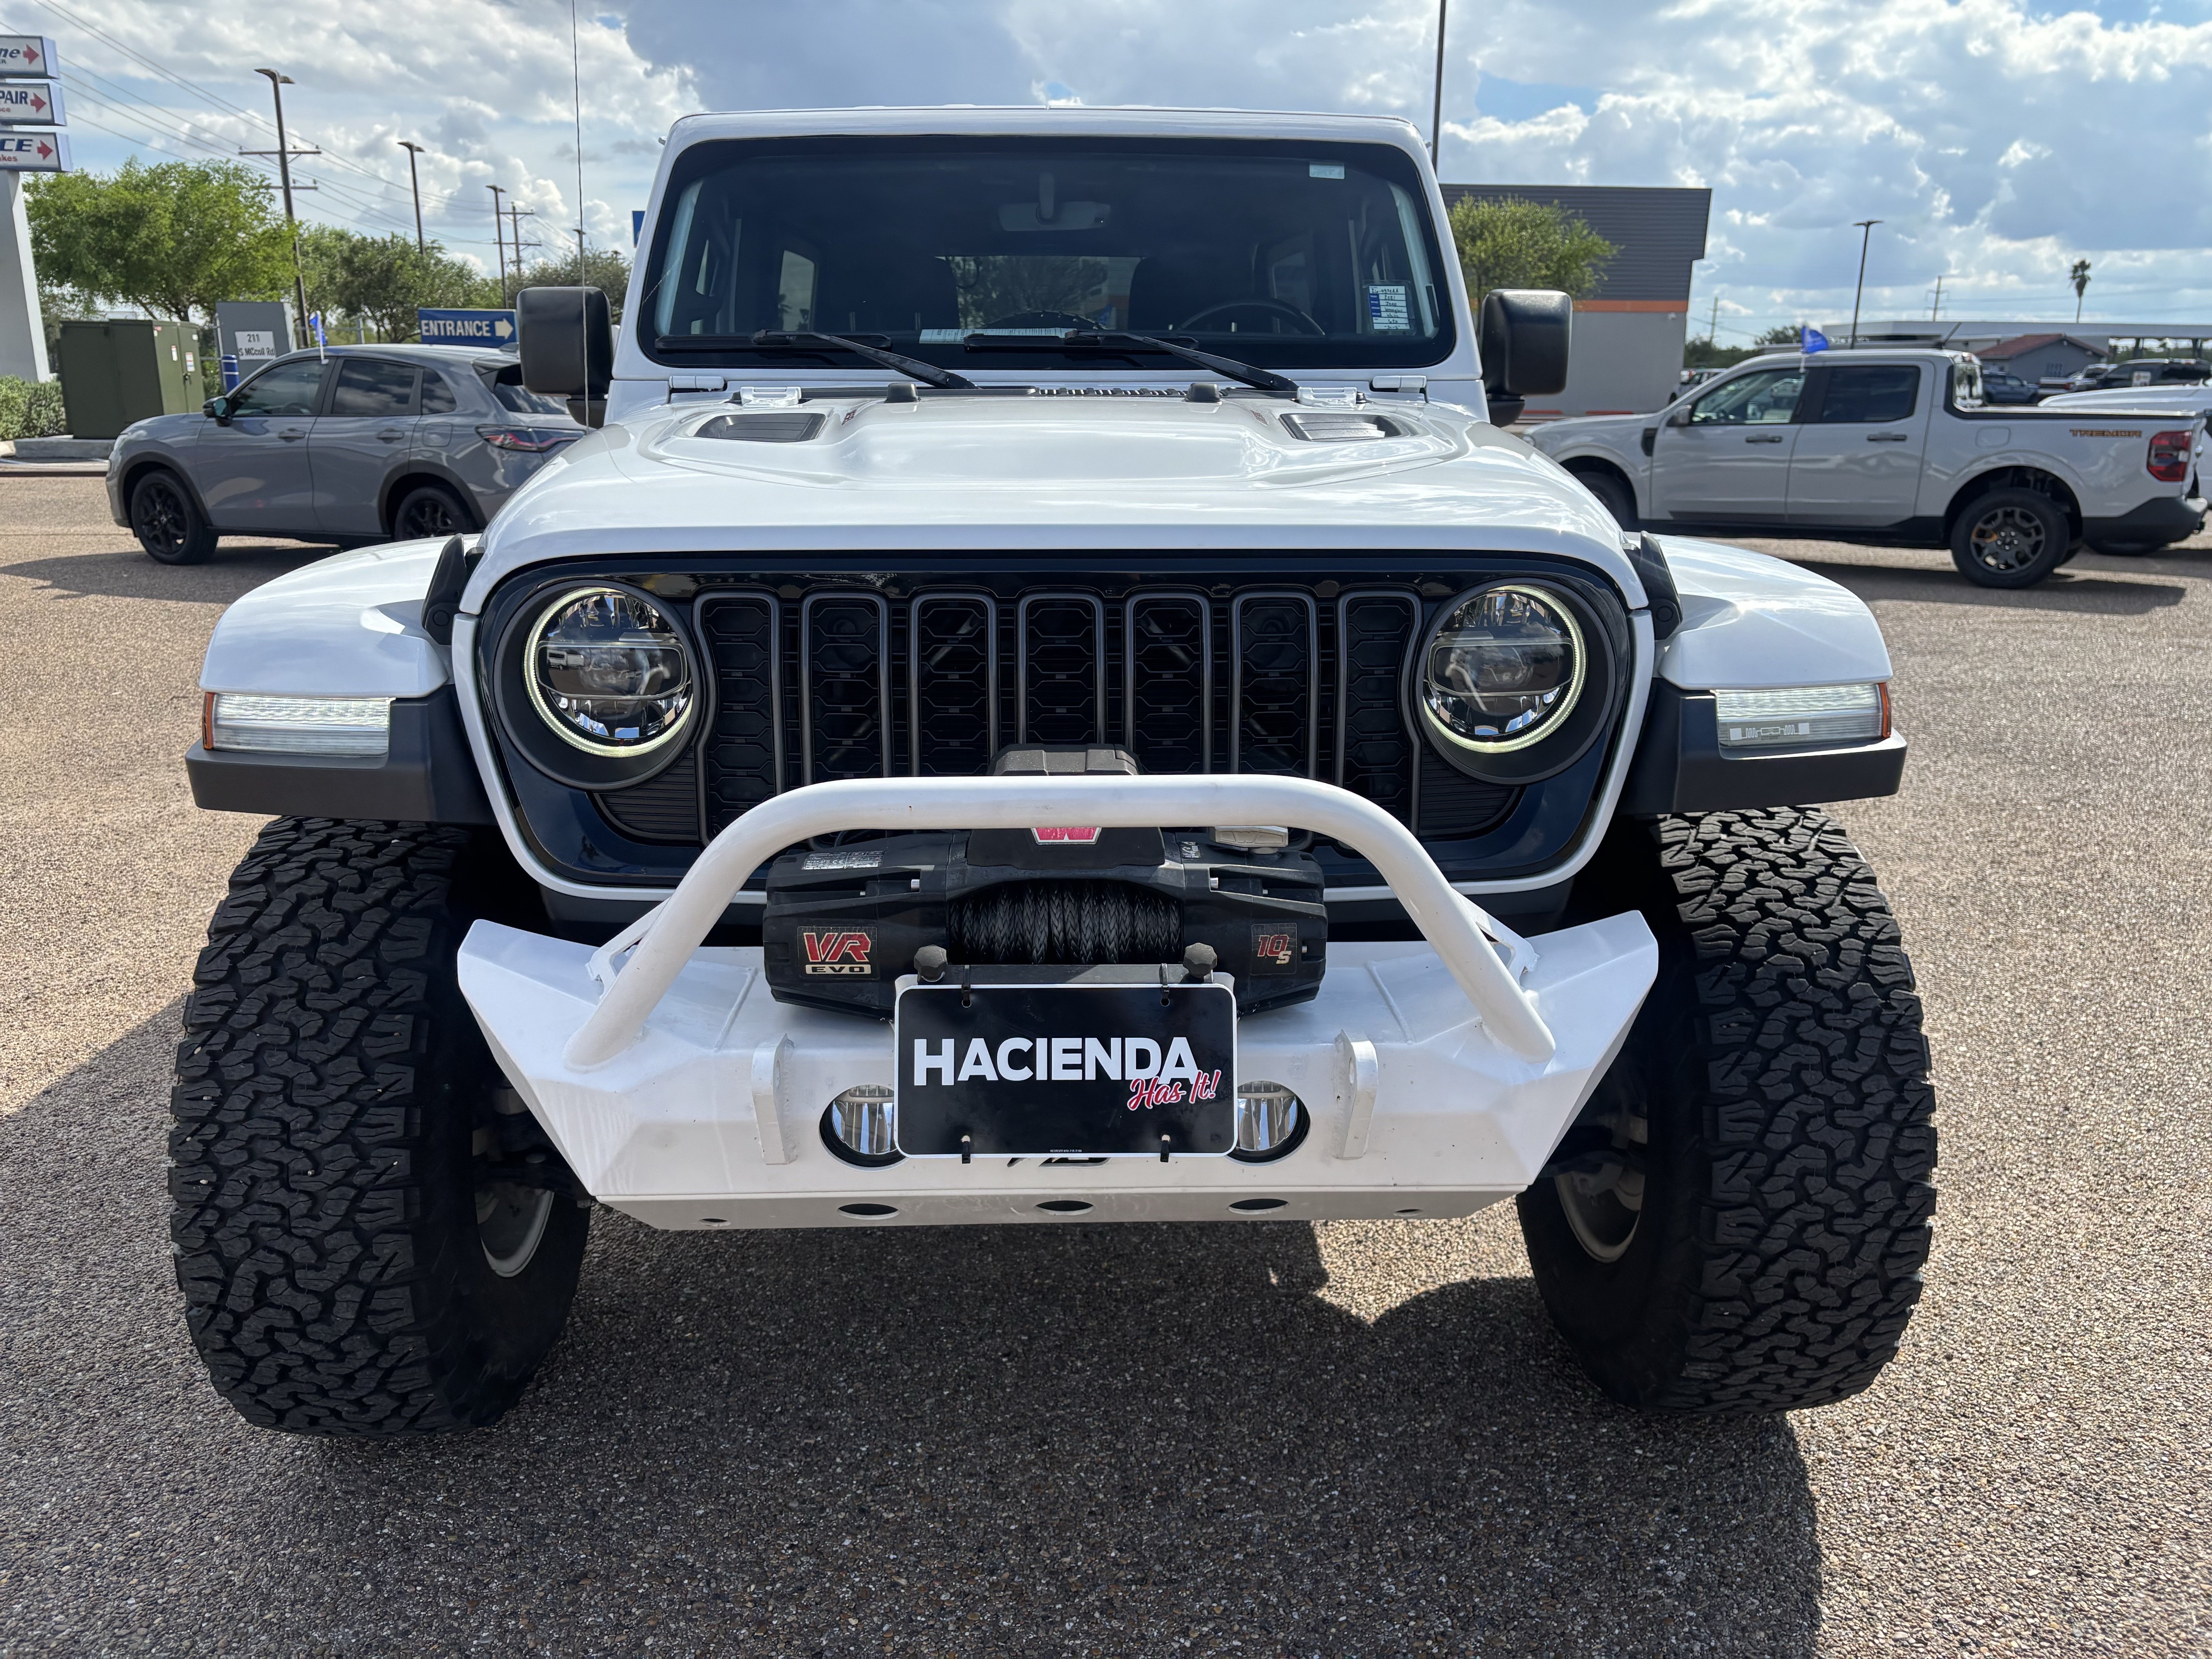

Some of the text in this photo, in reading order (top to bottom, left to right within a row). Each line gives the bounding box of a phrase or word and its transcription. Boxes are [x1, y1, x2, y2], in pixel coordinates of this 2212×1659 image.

[247, 334, 260, 342] 211
[421, 320, 491, 337] ENTRANCE
[2069, 429, 2142, 438] TREMOR
[803, 933, 871, 962] VR
[914, 1037, 1198, 1085] HACIENDA
[1127, 1069, 1221, 1111] Has It!
